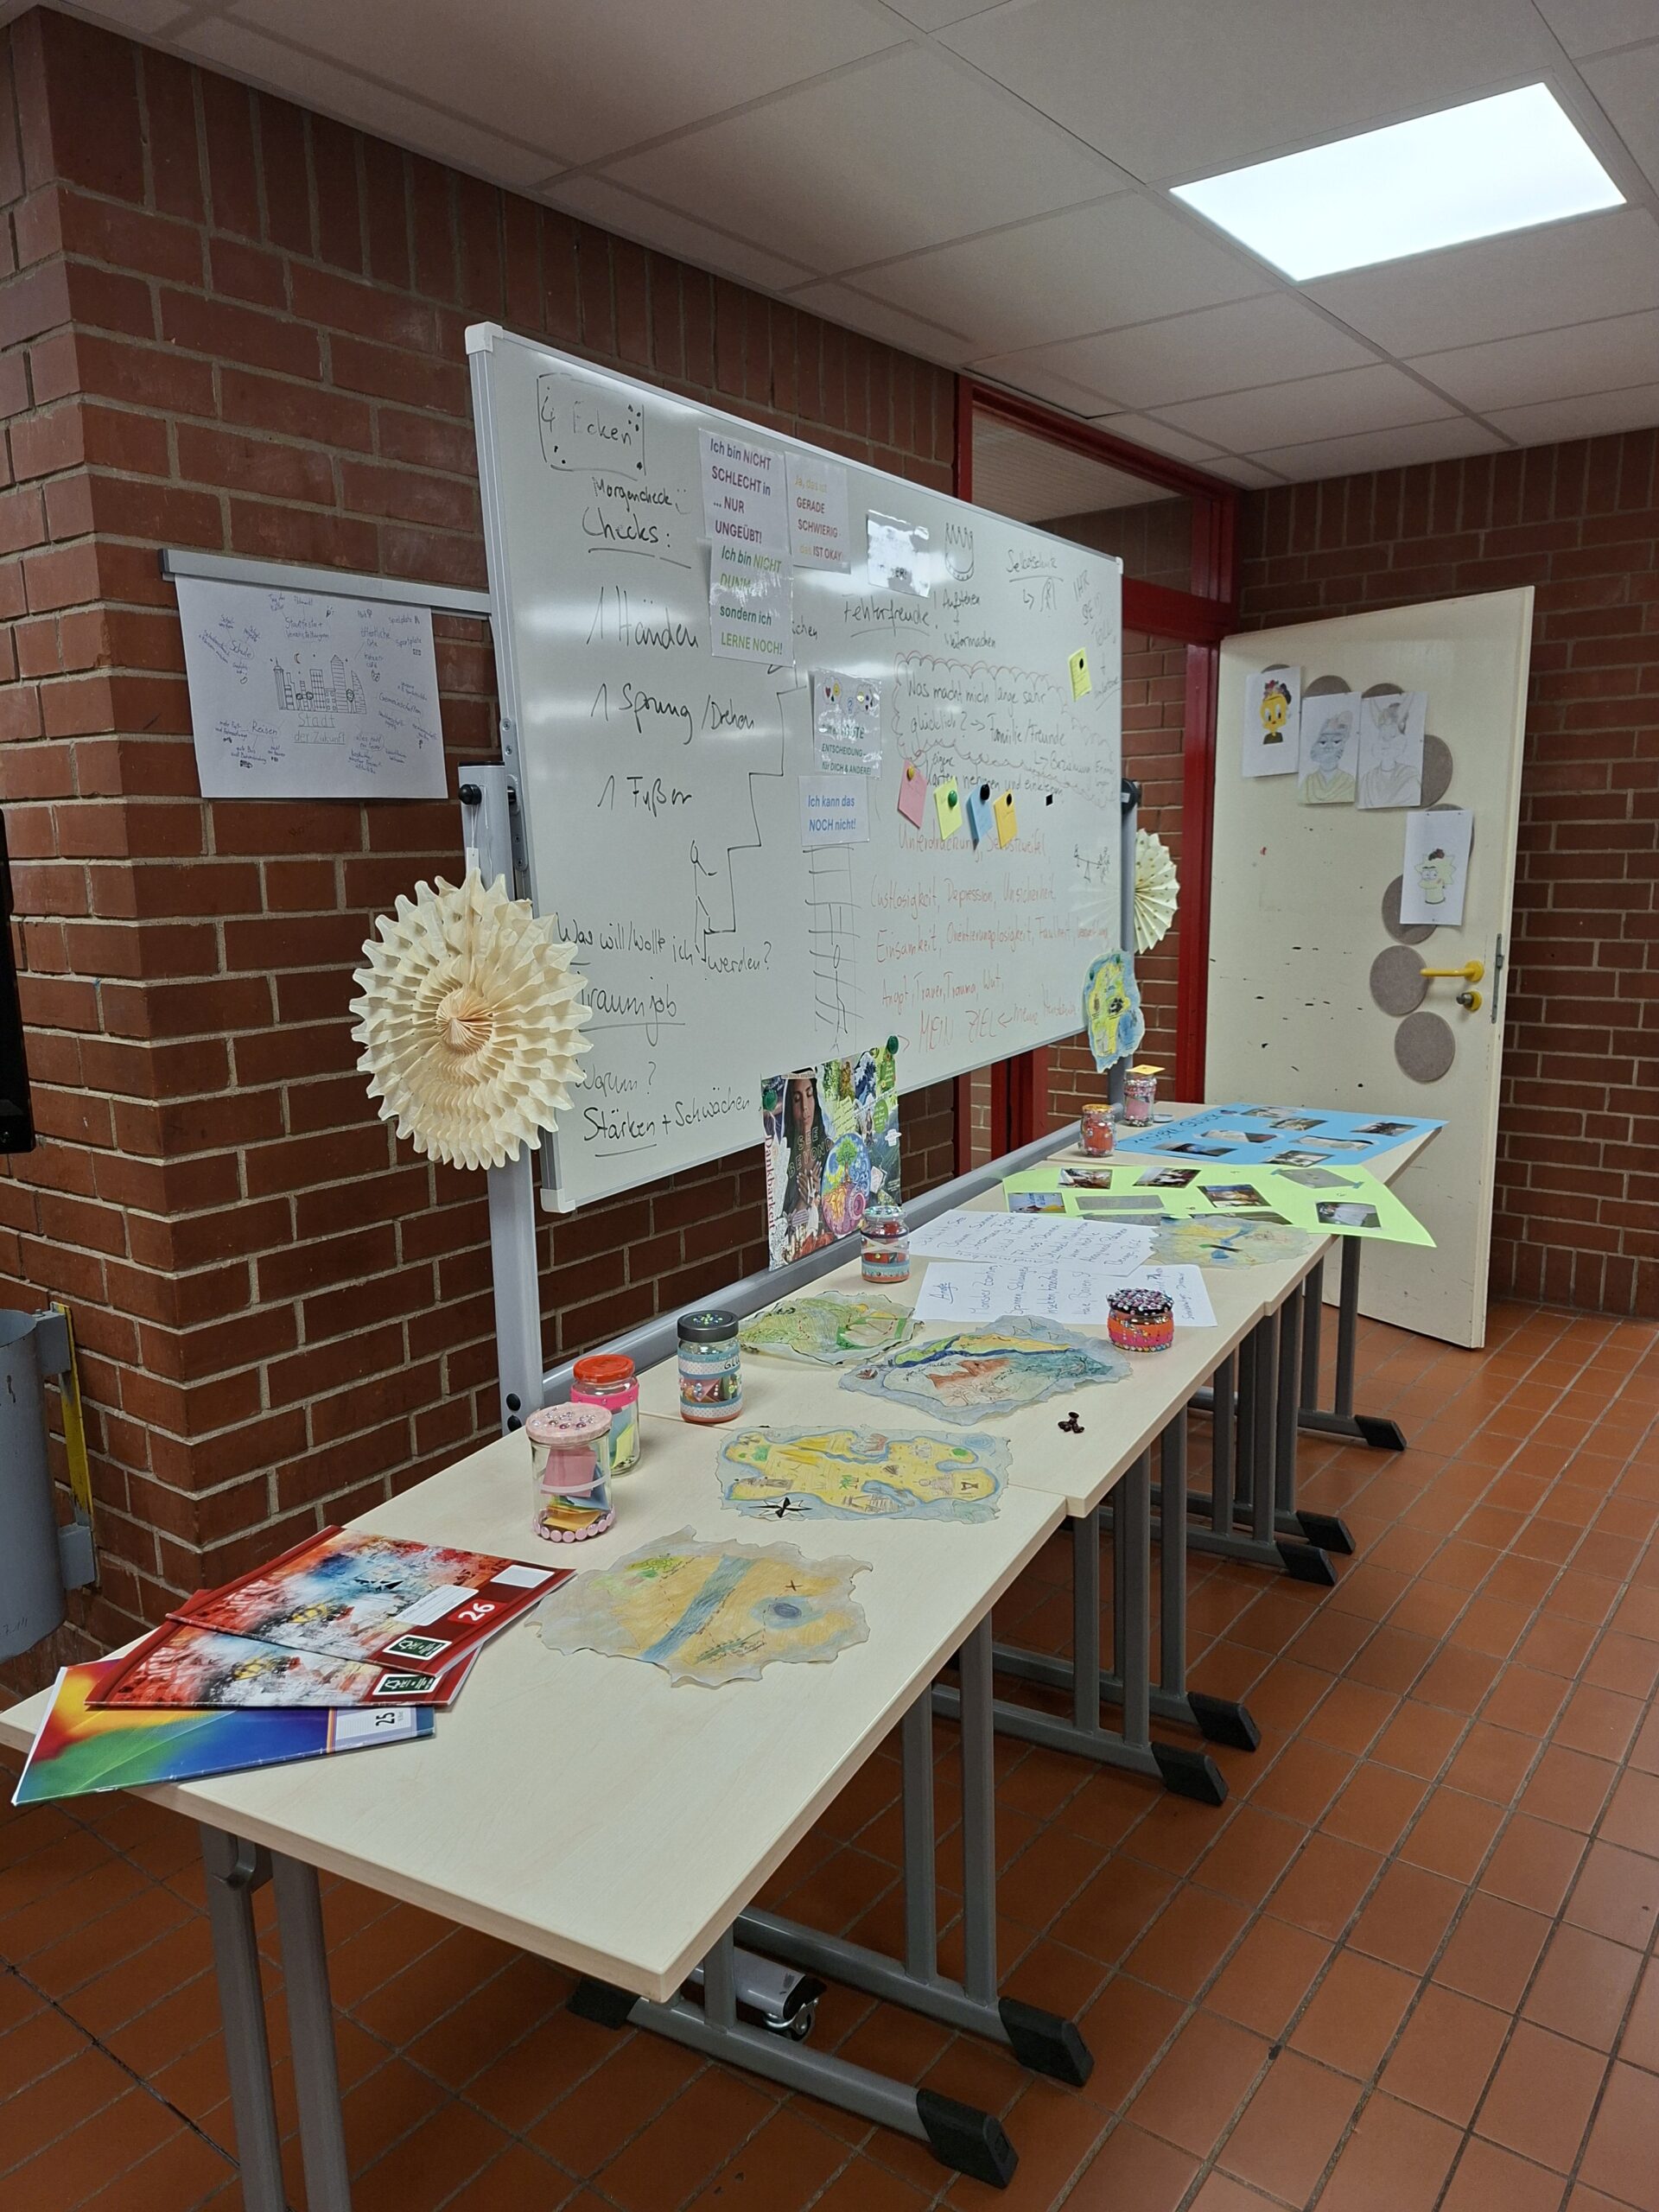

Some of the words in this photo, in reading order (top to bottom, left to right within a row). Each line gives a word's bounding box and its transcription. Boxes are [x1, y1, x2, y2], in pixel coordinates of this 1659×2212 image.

[573, 400, 632, 446] Ecken
[710, 438, 725, 454] Ich
[727, 443, 741, 460] bin
[743, 449, 772, 471] NICHT
[712, 466, 761, 493] SCHLECHT
[762, 482, 771, 496] in
[724, 496, 745, 514] NUR
[796, 497, 825, 514] GERADE
[715, 519, 762, 544] UNGEÜBT!
[798, 518, 838, 538] SCHWIERIG
[721, 545, 736, 562] Ich
[738, 550, 752, 566] bin
[753, 554, 782, 573] NICHT
[813, 544, 824, 558] IST
[720, 606, 757, 622] sondern
[759, 611, 772, 626] ich
[721, 632, 751, 650] LERNE
[753, 638, 783, 655] NOCH!
[908, 678, 930, 697] Was
[965, 682, 988, 704] mich
[251, 720, 278, 735] Reisen
[298, 711, 335, 727] Stadt
[294, 730, 309, 742] der
[311, 731, 346, 742] Zukunft
[822, 743, 862, 758] ENTSCHEIDUNG
[830, 762, 844, 772] DICH
[808, 794, 820, 807] Ich
[822, 795, 840, 807] kann
[842, 795, 855, 807] das
[809, 819, 834, 831] NOCH
[835, 817, 856, 831] nicht!
[556, 912, 594, 944] Was
[583, 1107, 655, 1141] Stärken
[798, 1126, 819, 1151] SEE
[787, 1136, 833, 1179] BEYOND
[766, 1135, 776, 1229] Dankbarkeit
[458, 1603, 496, 1622] 26
[376, 1712, 395, 1726] 25
